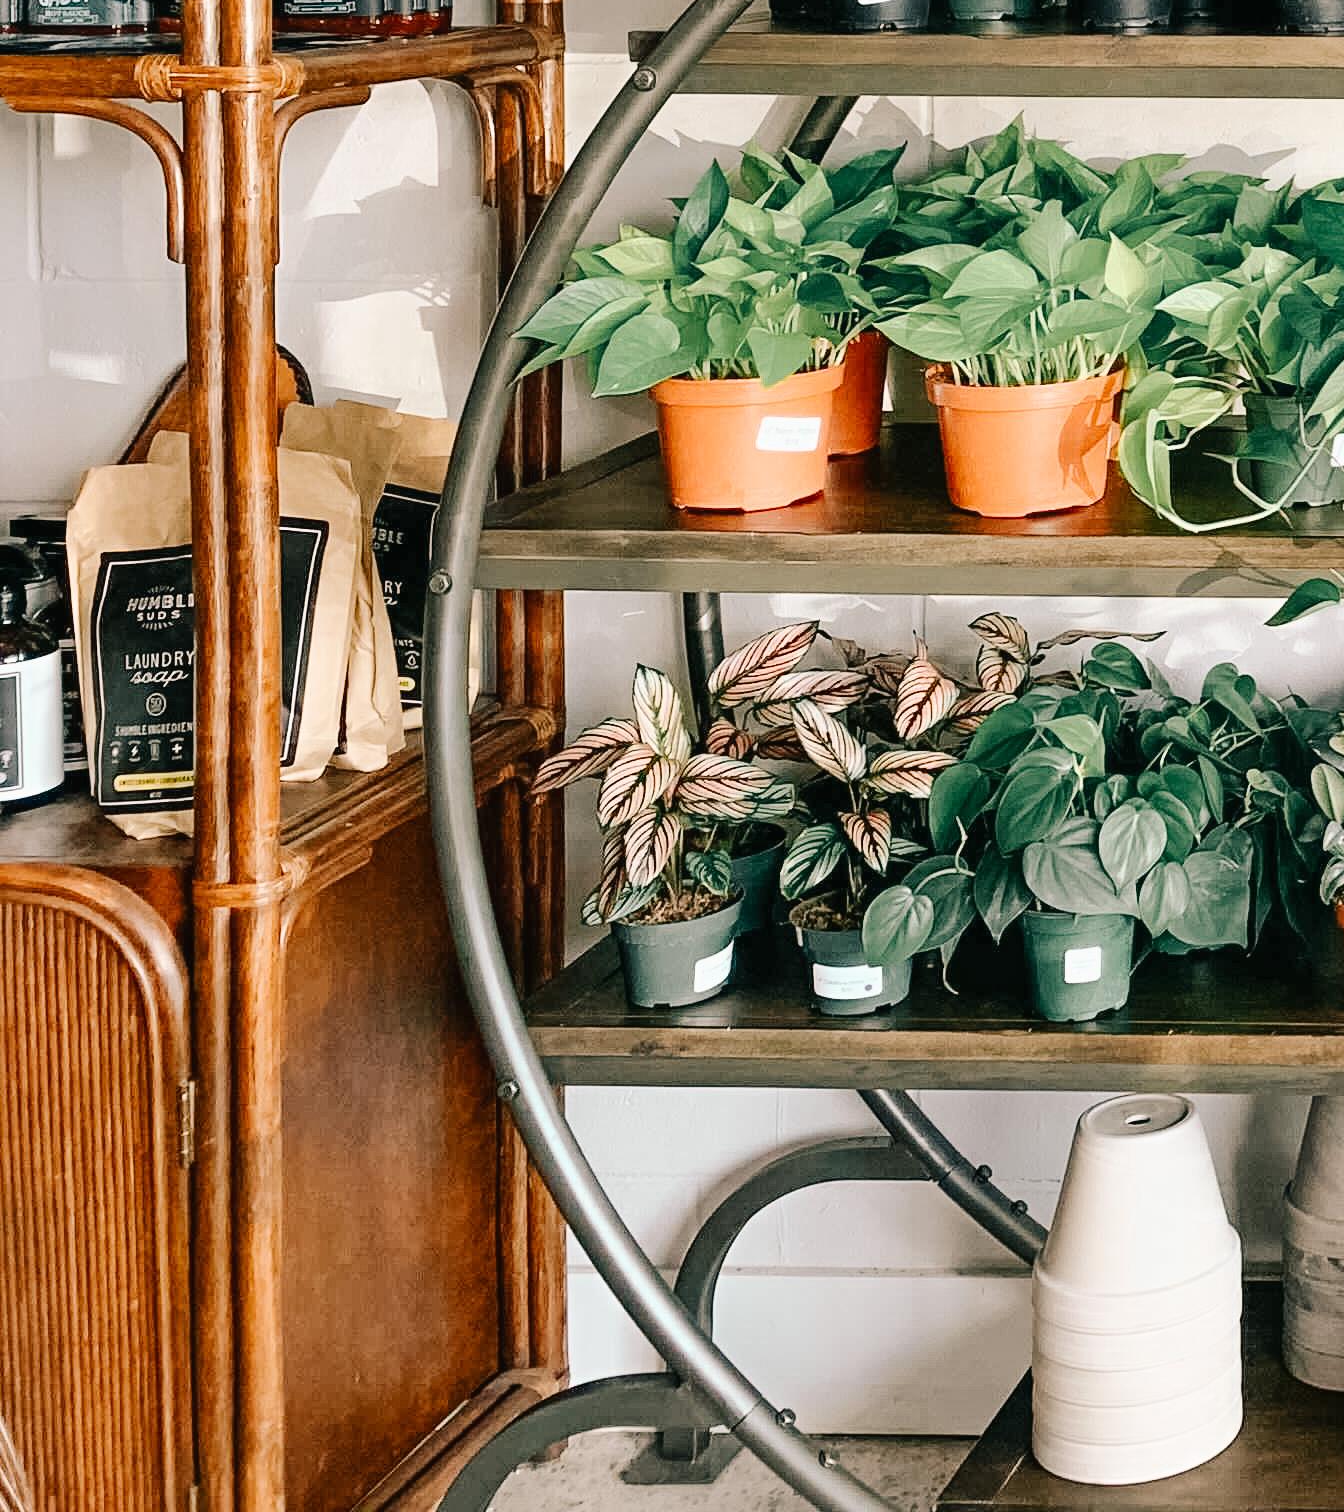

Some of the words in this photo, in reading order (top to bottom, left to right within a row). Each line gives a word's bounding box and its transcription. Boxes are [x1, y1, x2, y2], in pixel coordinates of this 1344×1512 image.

[137, 609, 181, 622] SUDS
[125, 650, 195, 670] LAUNDRY
[130, 669, 189, 688] soap
